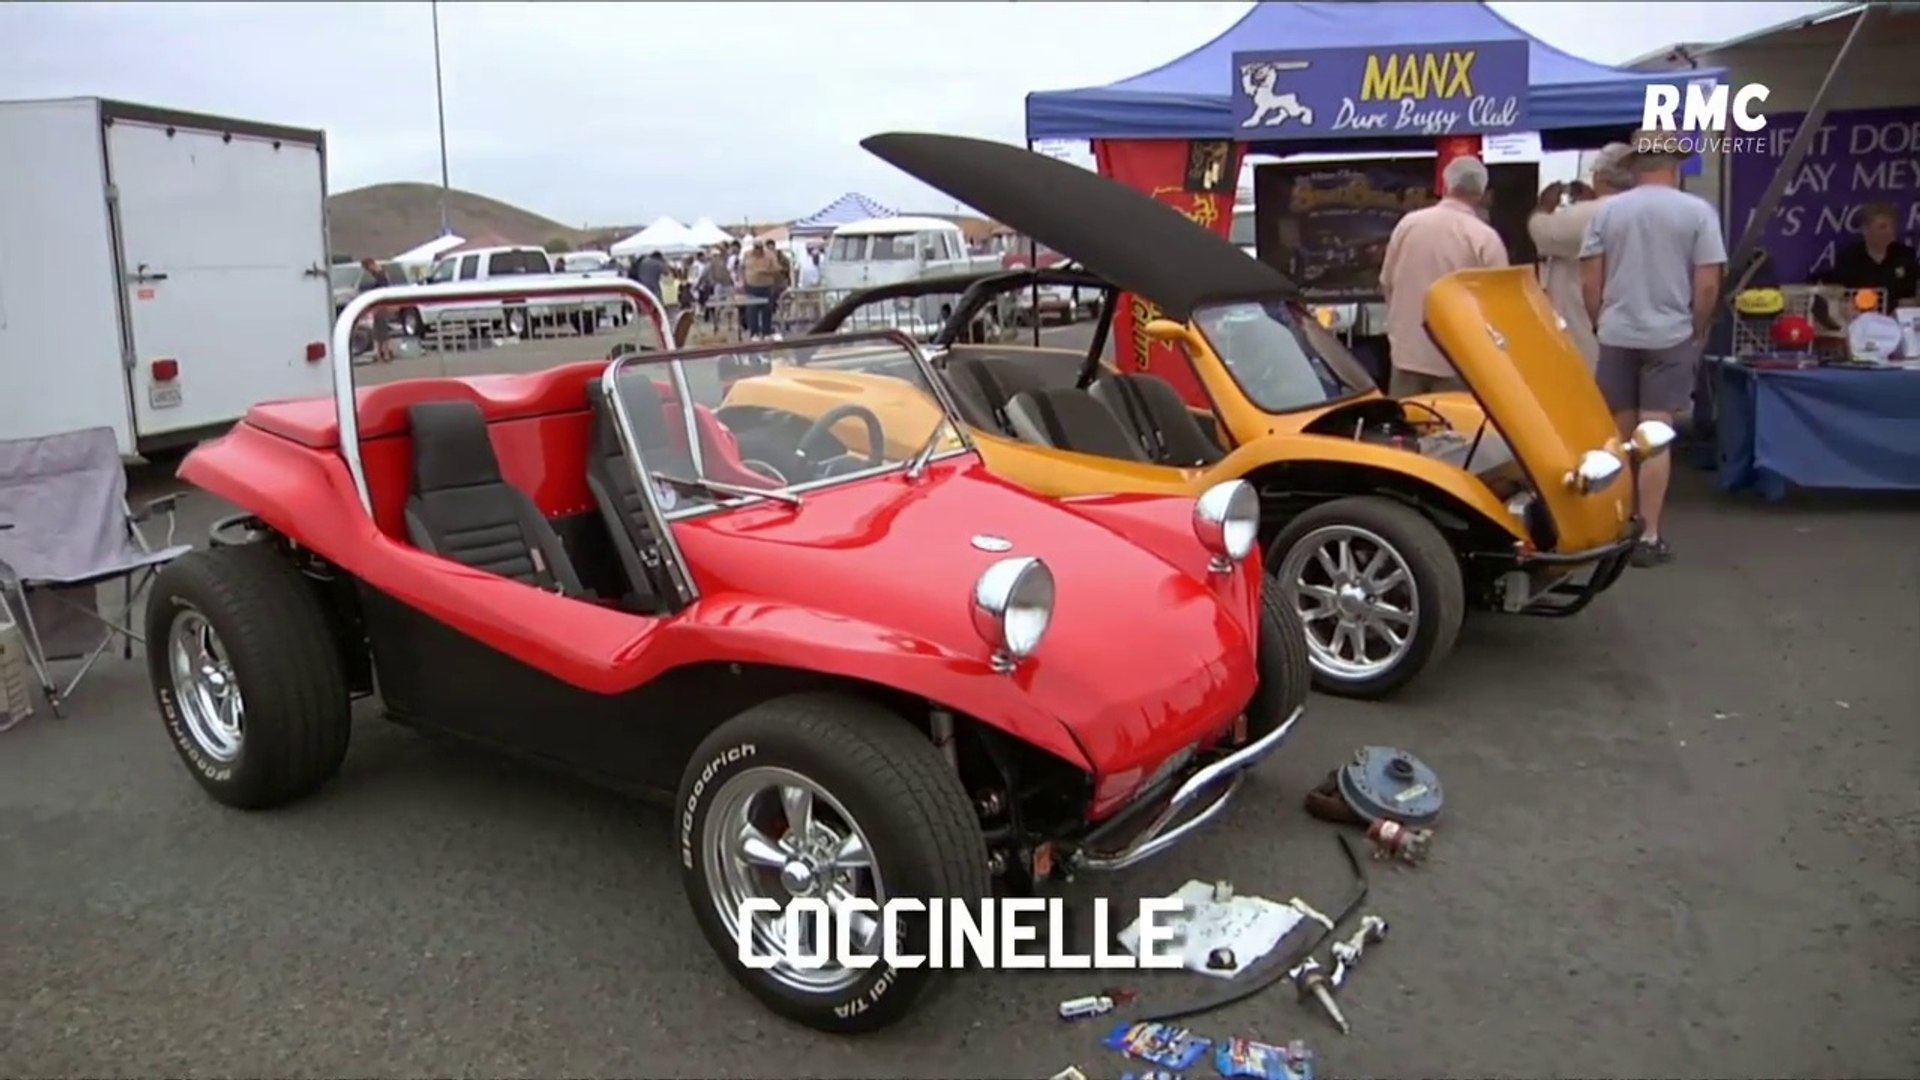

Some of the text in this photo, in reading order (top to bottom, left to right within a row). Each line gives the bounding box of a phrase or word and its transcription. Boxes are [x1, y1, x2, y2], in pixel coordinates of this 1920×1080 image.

[1360, 51, 1476, 101] MANX
[1394, 96, 1461, 134] Buggy
[1468, 94, 1520, 128] Club
[680, 742, 757, 870] BFGoodrich
